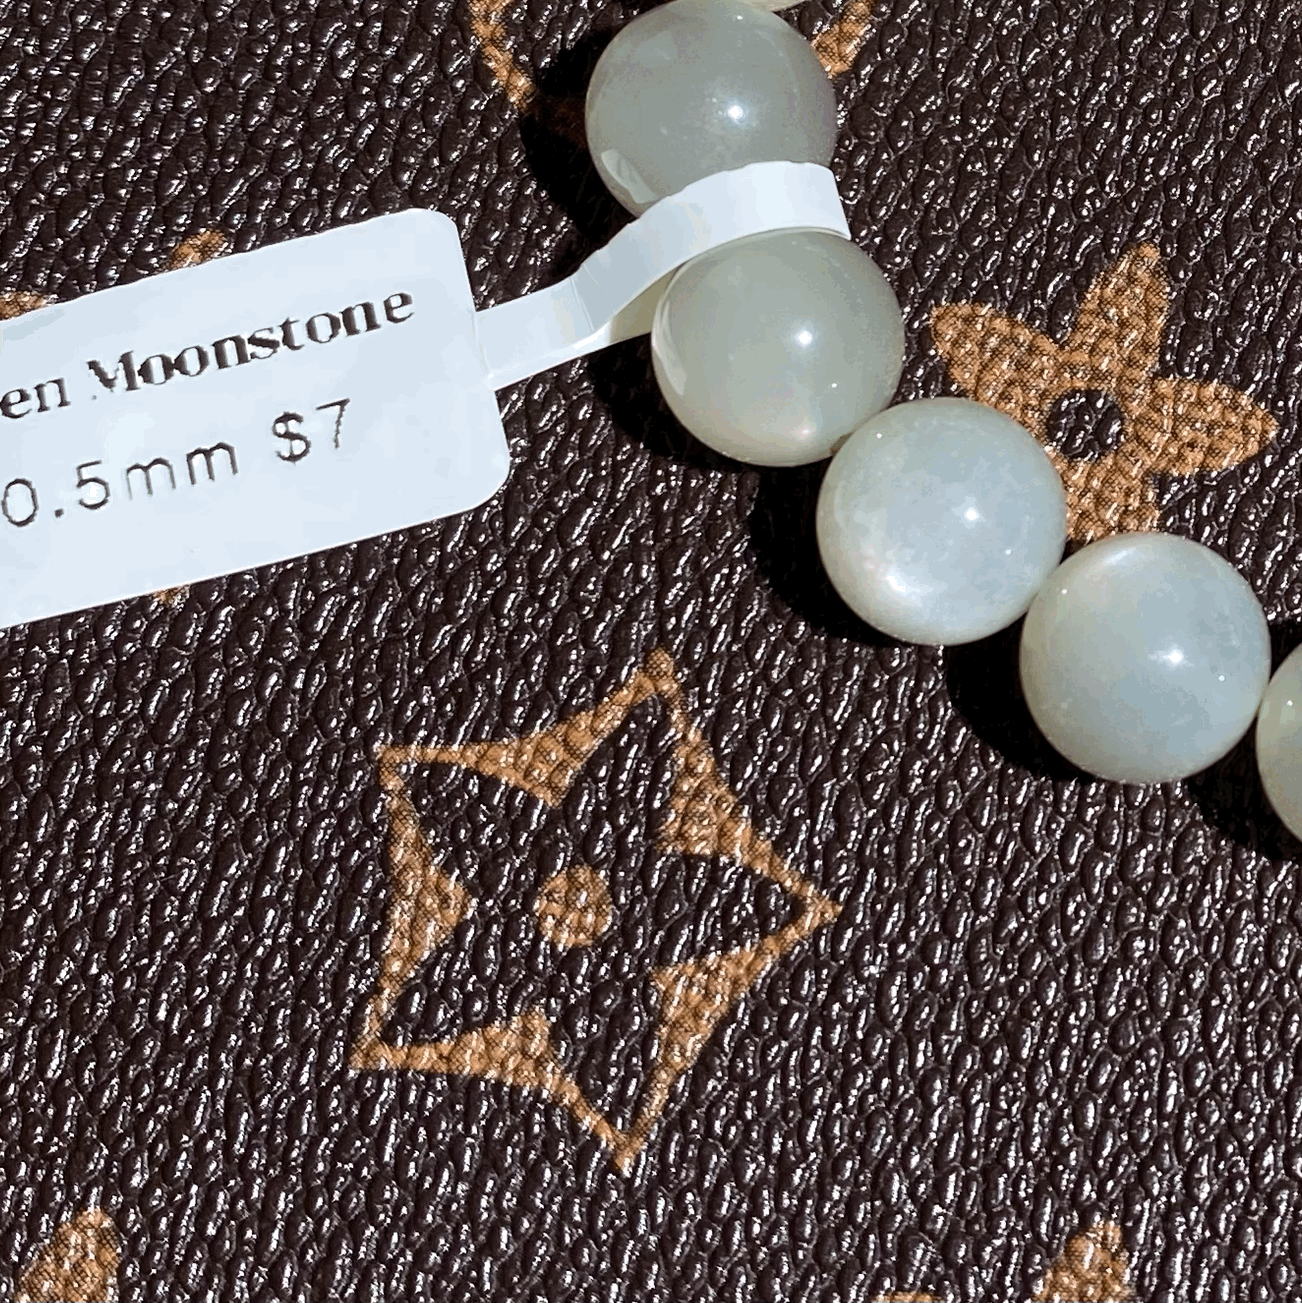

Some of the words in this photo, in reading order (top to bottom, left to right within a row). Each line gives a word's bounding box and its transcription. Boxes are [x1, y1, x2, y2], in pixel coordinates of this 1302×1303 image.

[87, 291, 414, 400] Moonstone
[1, 442, 239, 528] 0.5mm
[271, 398, 350, 464] $7
